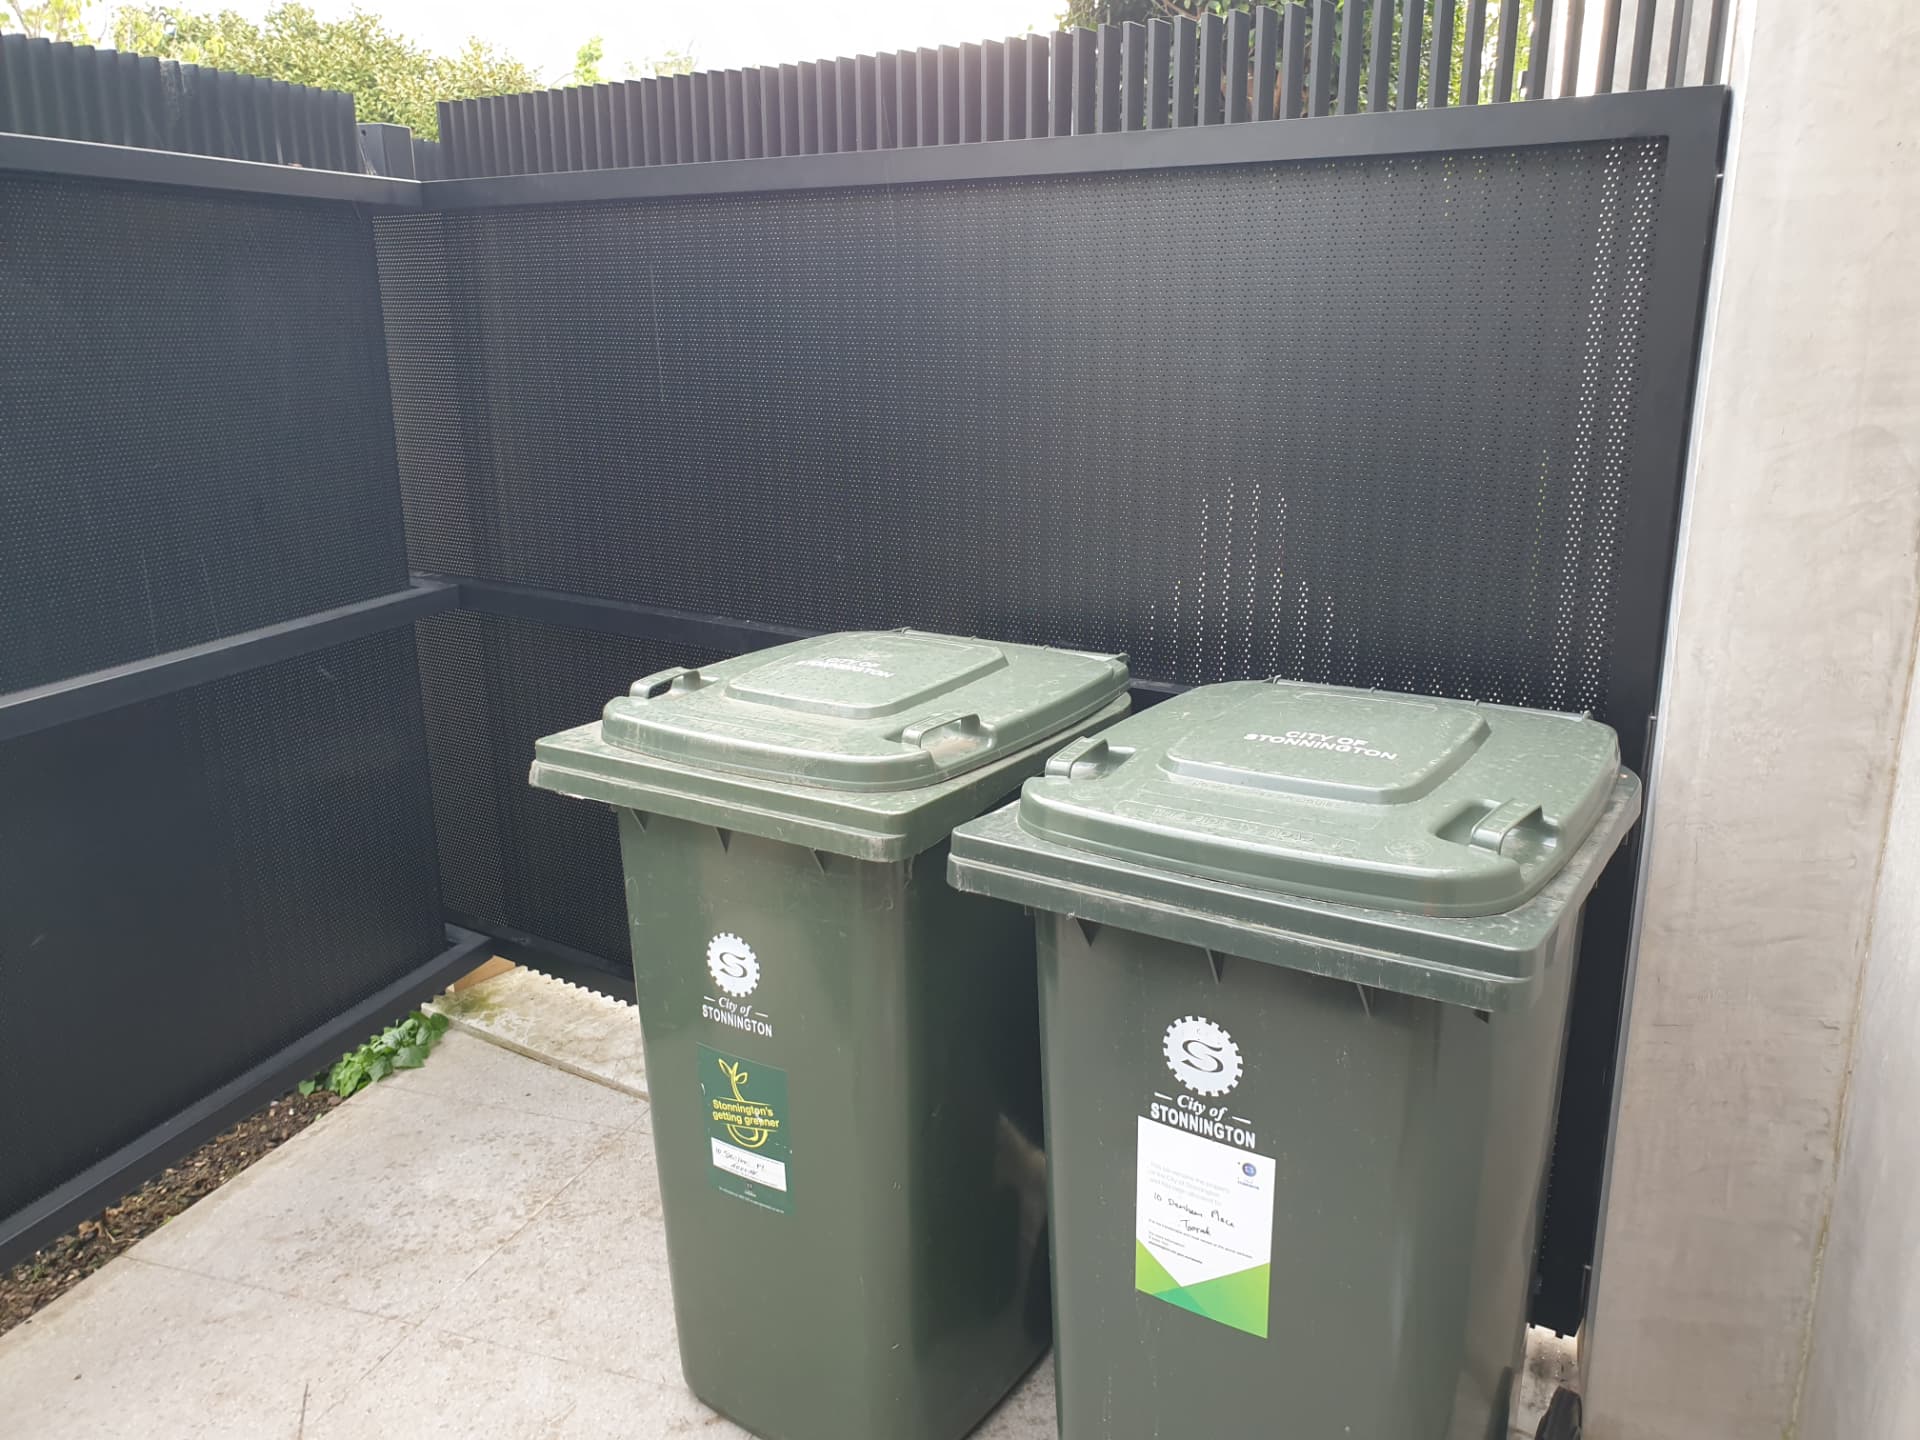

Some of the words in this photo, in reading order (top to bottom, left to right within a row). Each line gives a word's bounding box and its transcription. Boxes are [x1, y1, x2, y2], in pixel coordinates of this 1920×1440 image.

[1243, 733, 1398, 760] STONNINGTON
[1286, 731, 1334, 742] CITY
[1337, 737, 1369, 747] OF
[718, 997, 738, 1013] City
[740, 1005, 753, 1017] of
[702, 1004, 773, 1037] STONNINGTON
[712, 1099, 774, 1117] Stonnington's
[1176, 1094, 1206, 1116] City
[1209, 1106, 1228, 1121] of
[712, 1111, 743, 1125] getting
[744, 1116, 780, 1128] greener
[1150, 1102, 1256, 1149] STONNINGTON
